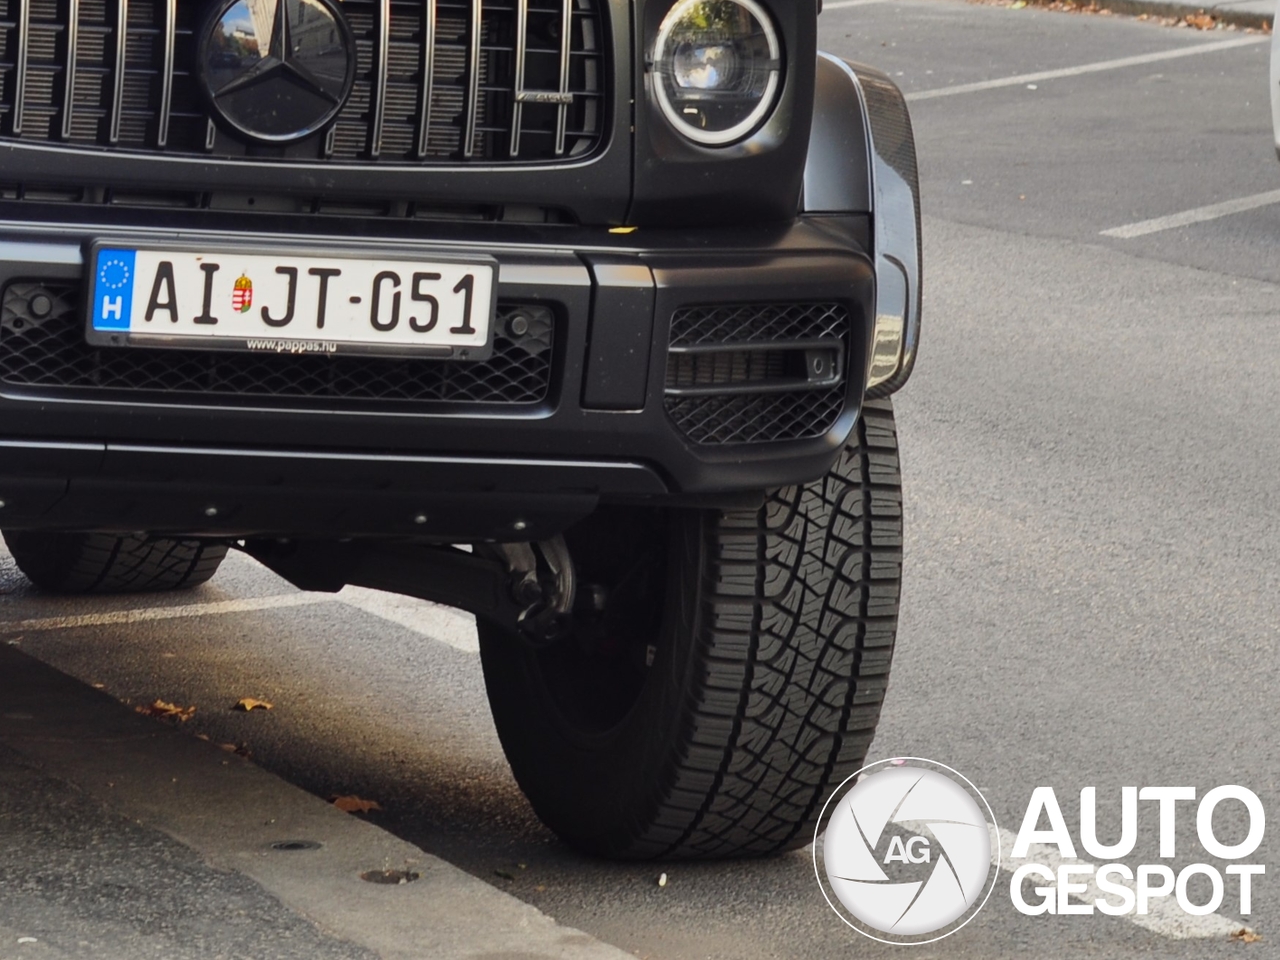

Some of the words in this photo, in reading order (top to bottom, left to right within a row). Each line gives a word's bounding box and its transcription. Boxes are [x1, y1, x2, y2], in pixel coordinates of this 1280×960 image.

[102, 295, 122, 320] H
[144, 260, 220, 325] AI
[260, 266, 477, 334] JT-051
[246, 339, 337, 354] www.pappas.hu
